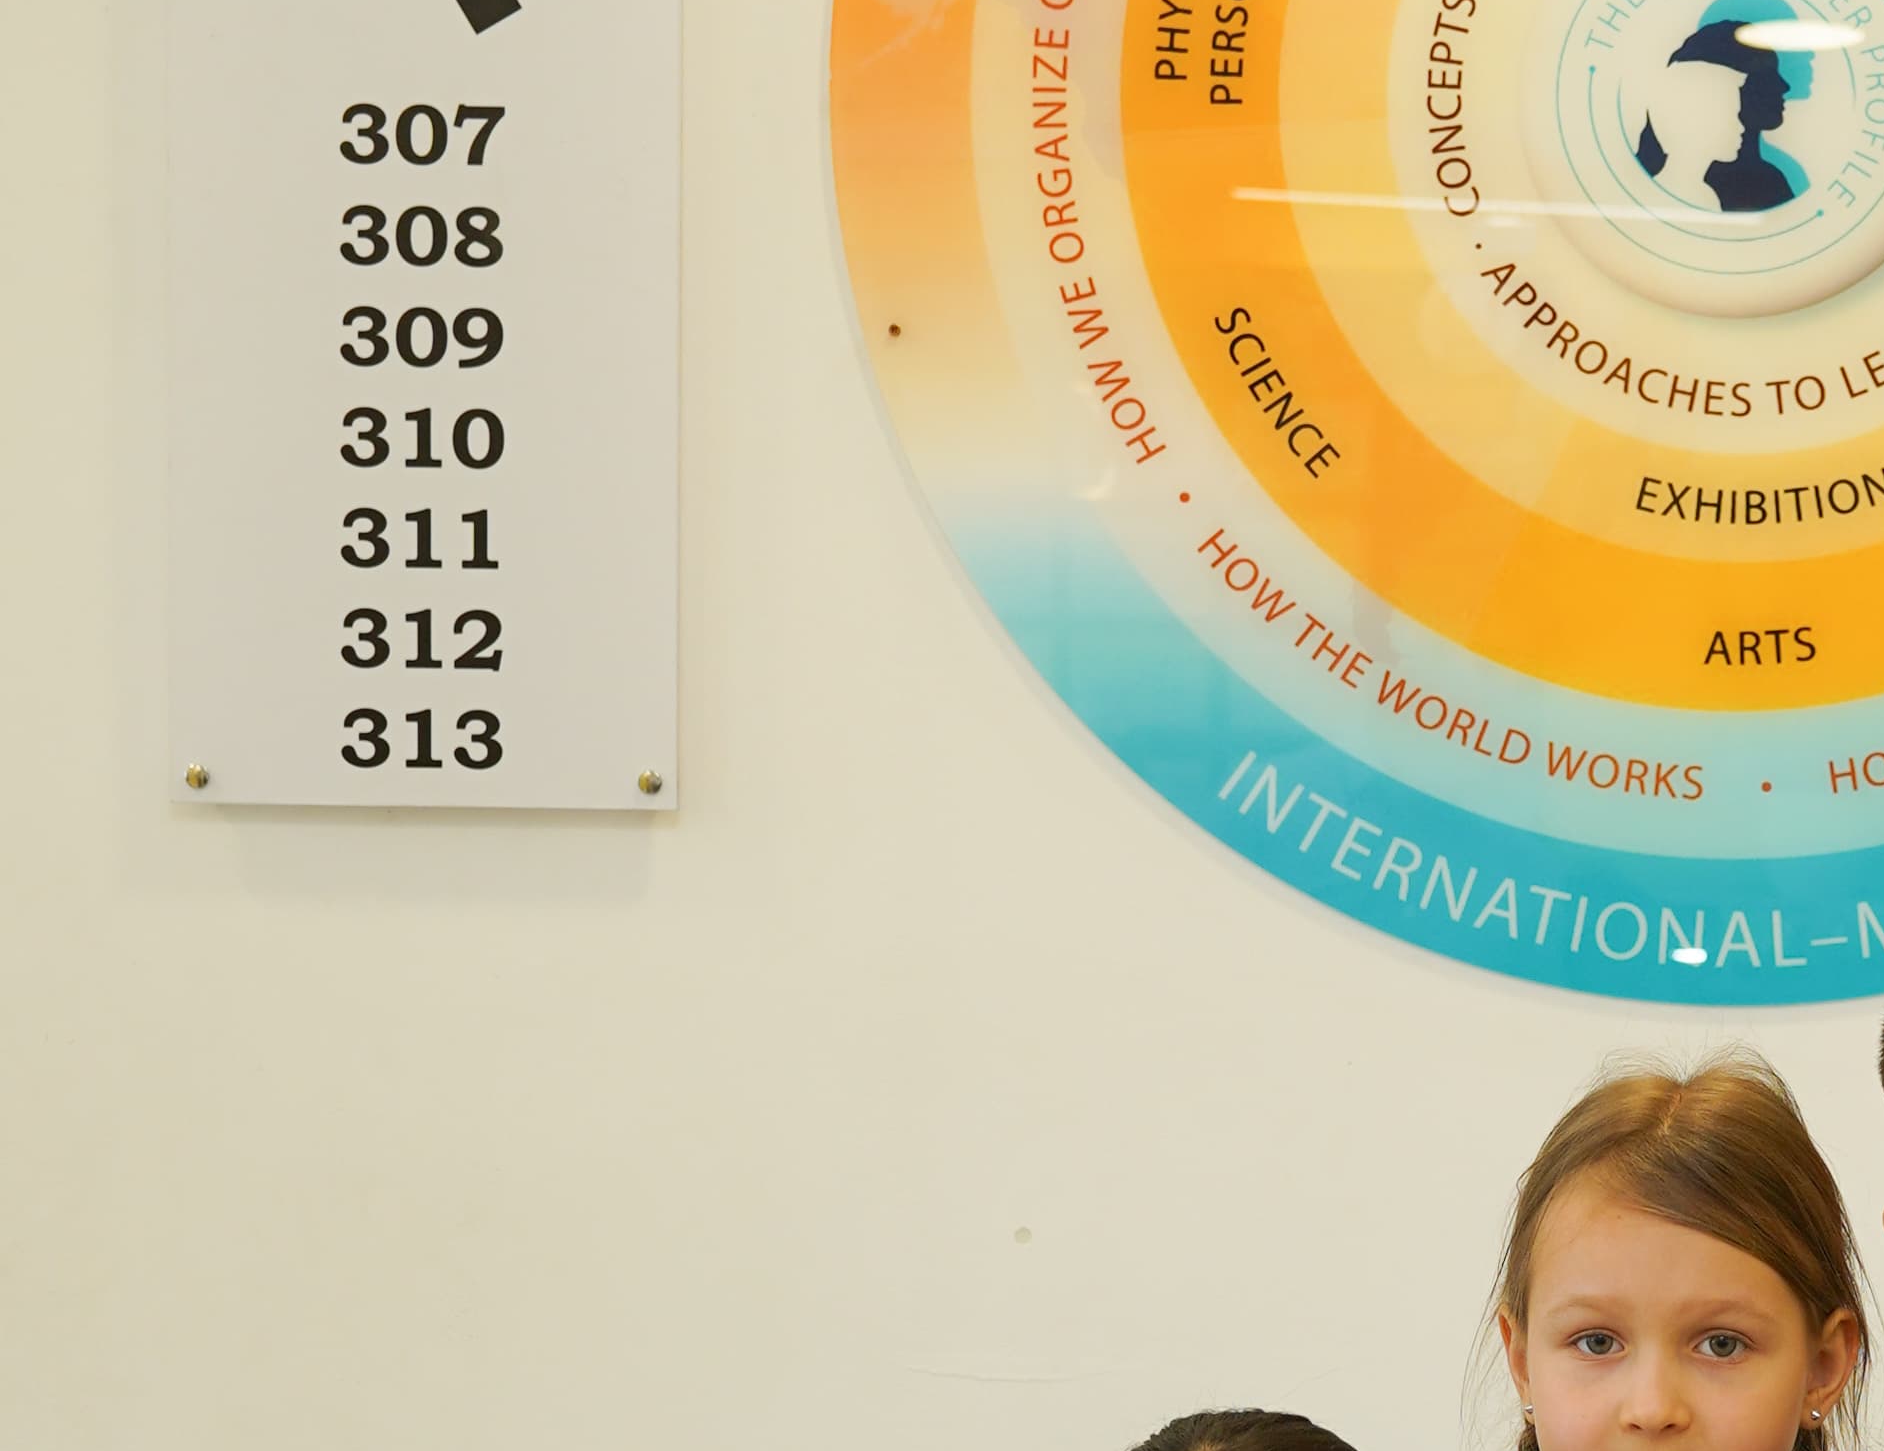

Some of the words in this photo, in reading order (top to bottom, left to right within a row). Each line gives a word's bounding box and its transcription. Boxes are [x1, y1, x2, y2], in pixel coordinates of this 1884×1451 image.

[340, 104, 506, 166] 307
[1032, 26, 1085, 265] ORGANIZE
[340, 205, 504, 268] 308
[340, 306, 504, 369] 309
[1059, 276, 1110, 351] WE
[1480, 261, 1752, 418] APPROACHES
[1765, 375, 1827, 417] TO
[1086, 358, 1167, 465] HOW
[1214, 307, 1341, 479] SCIENCE
[341, 407, 505, 470] 310
[341, 508, 499, 570] 311
[341, 608, 503, 672] 312
[1197, 527, 1297, 626] HOW
[1292, 613, 1375, 690] THE
[1376, 670, 1533, 767] WORLD
[1546, 742, 1706, 803] WORKS
[1703, 625, 1819, 668] ARTS
[342, 708, 503, 770] 313
